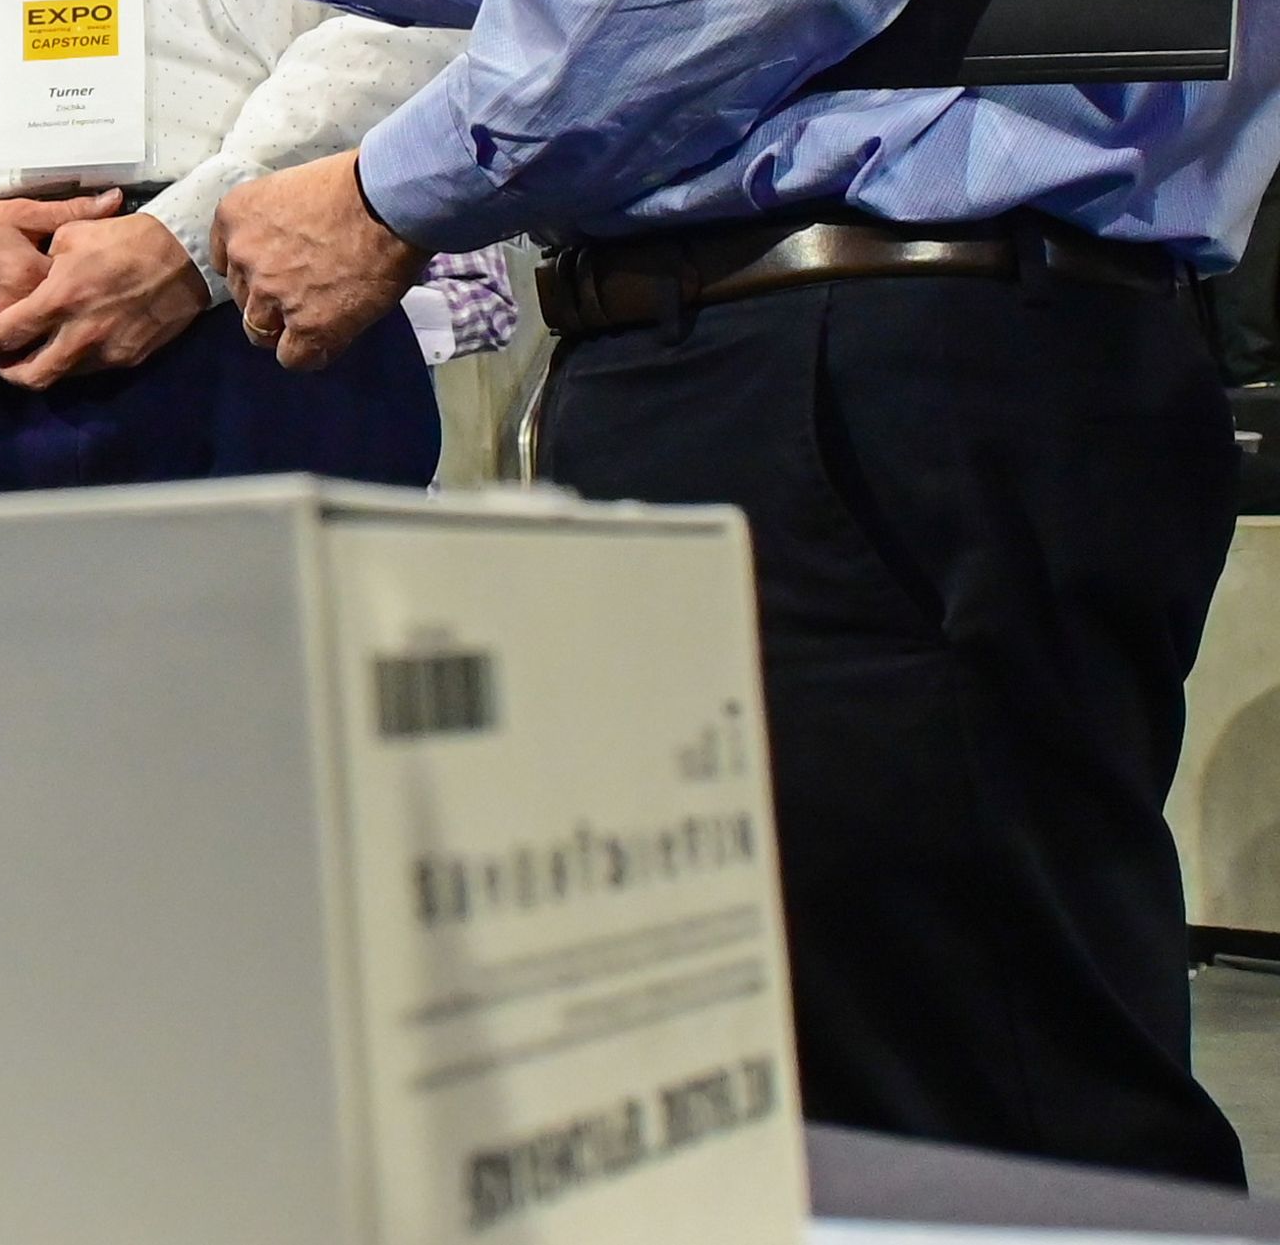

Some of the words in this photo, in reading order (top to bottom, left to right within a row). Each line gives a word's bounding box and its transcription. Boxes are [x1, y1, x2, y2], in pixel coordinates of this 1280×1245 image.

[28, 4, 113, 25] EXPO
[31, 34, 111, 50] CAPSTONE
[48, 87, 95, 98] Turner
